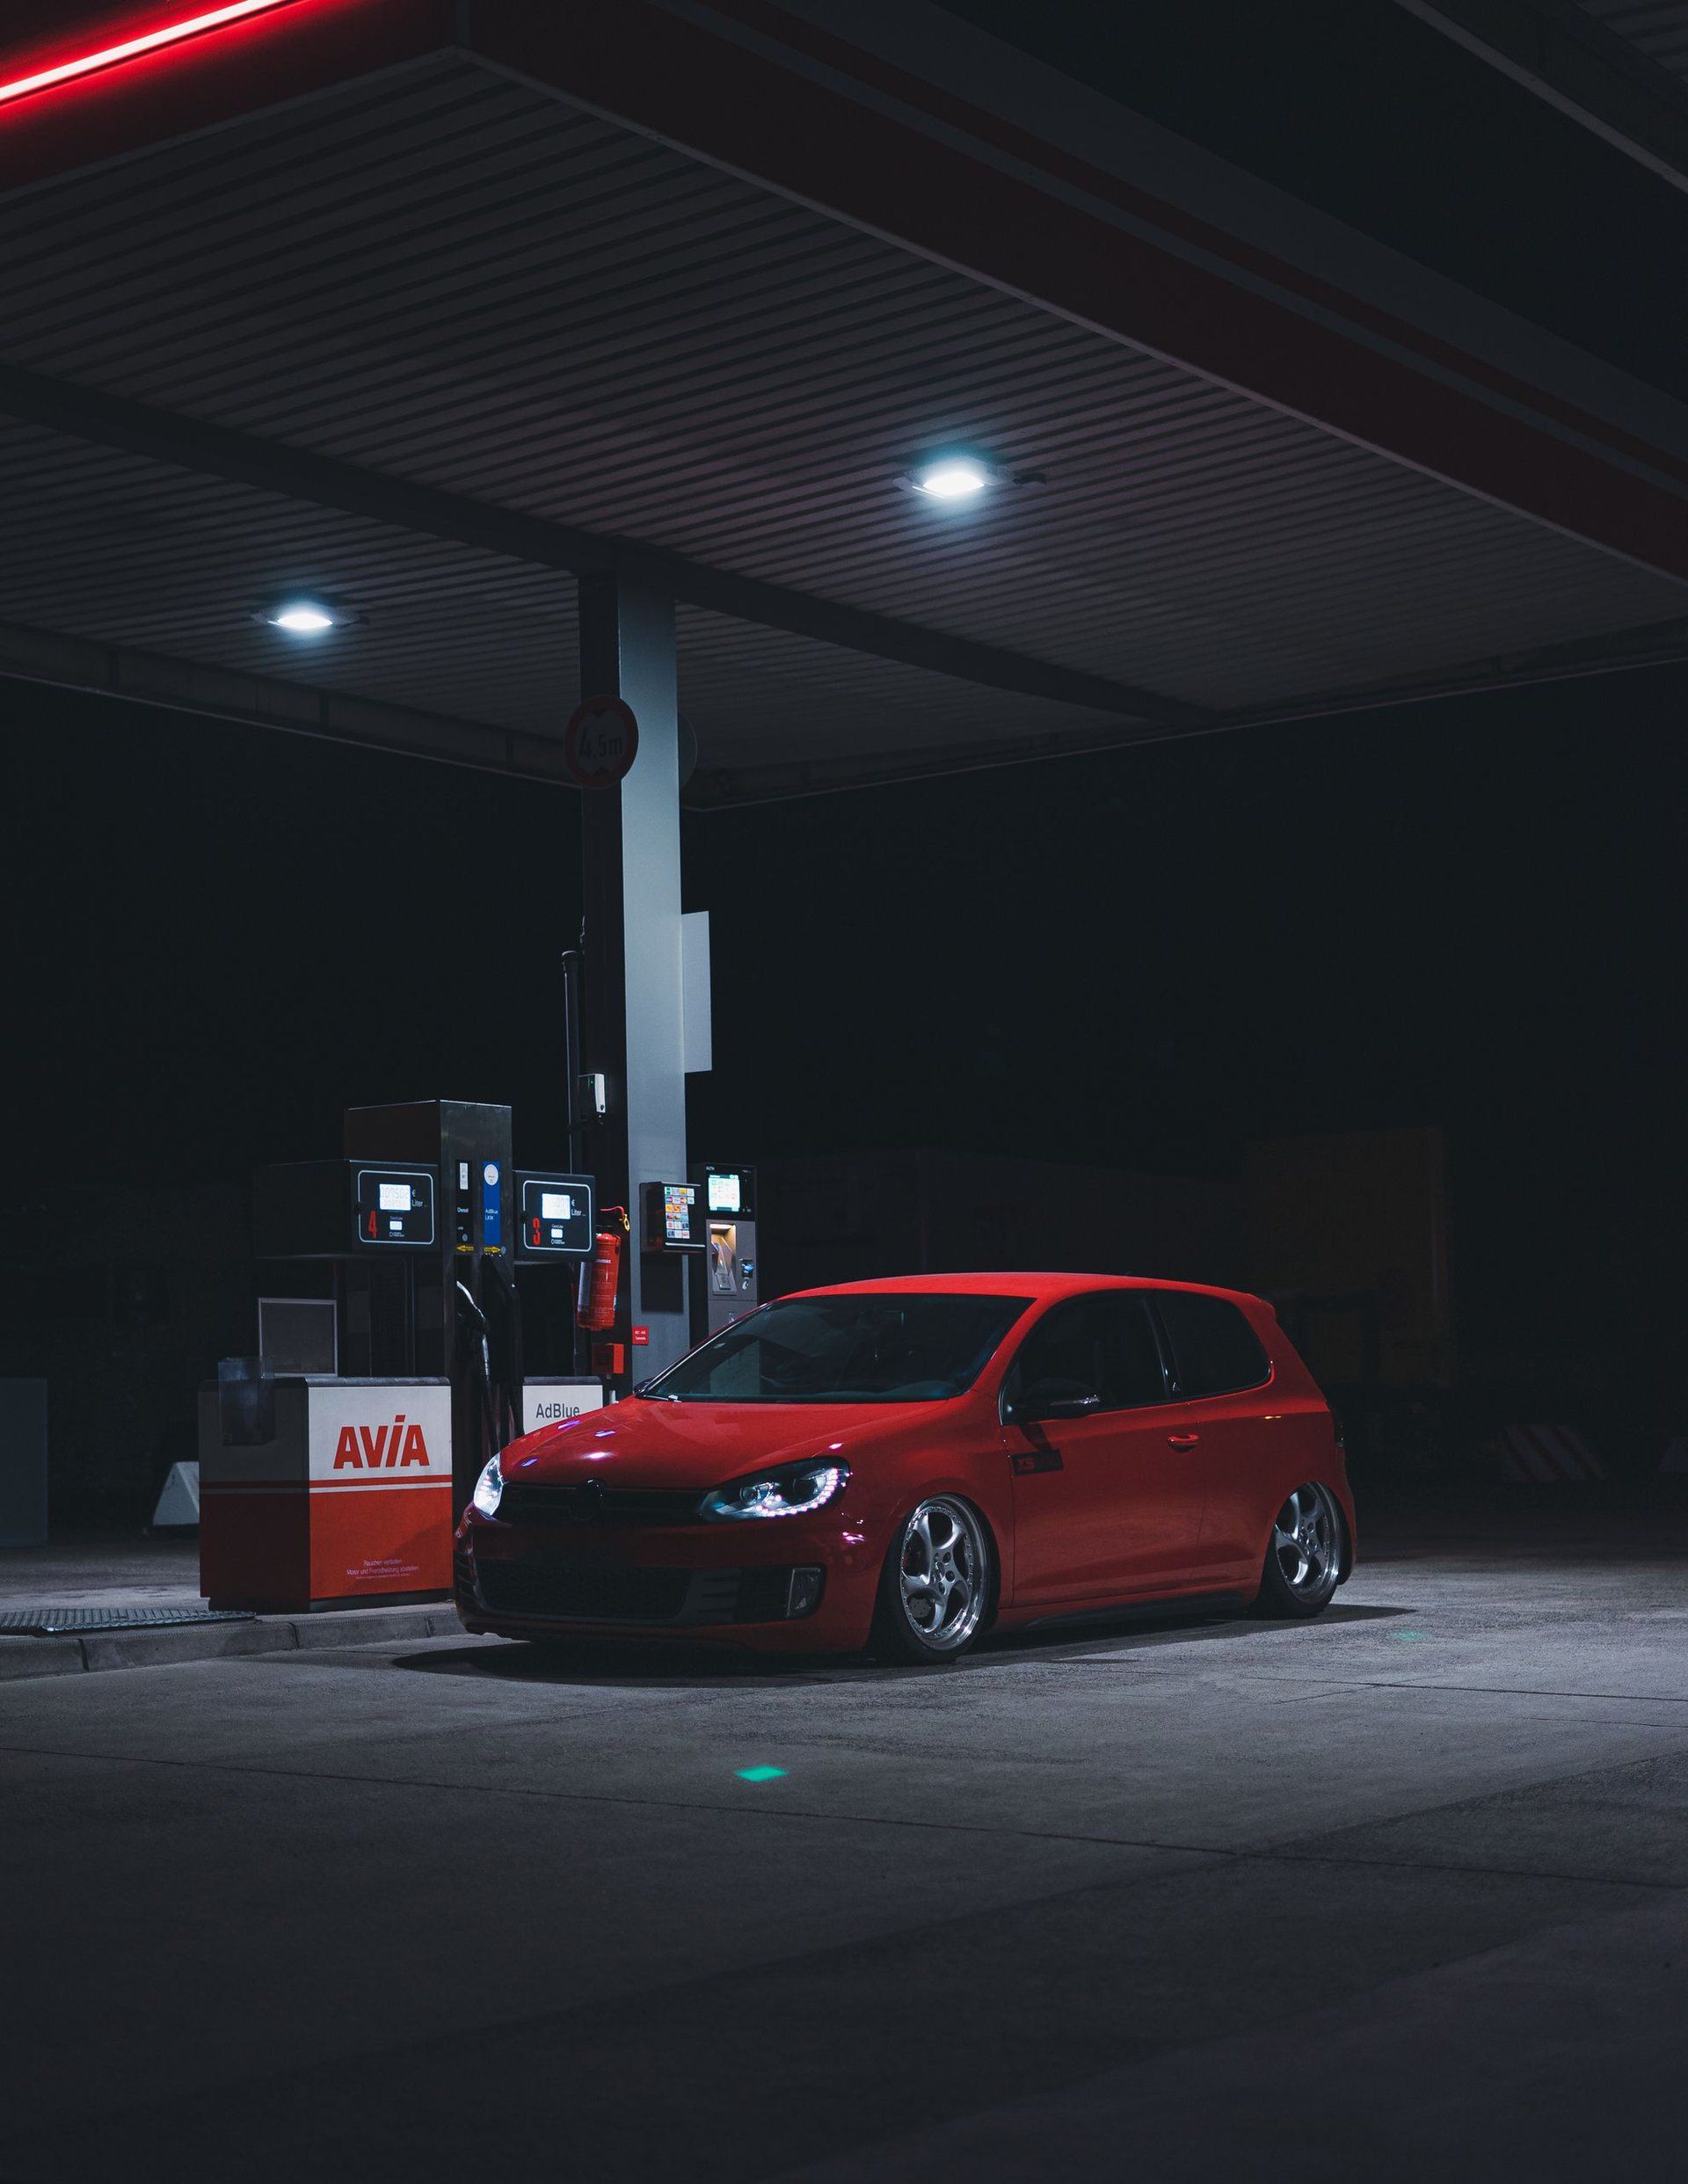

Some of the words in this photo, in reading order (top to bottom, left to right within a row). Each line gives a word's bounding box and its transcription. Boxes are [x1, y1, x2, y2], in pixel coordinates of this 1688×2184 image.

[368, 1210, 377, 1239] 4
[532, 1217, 541, 1246] 3
[535, 1403, 580, 1418] AdBlue
